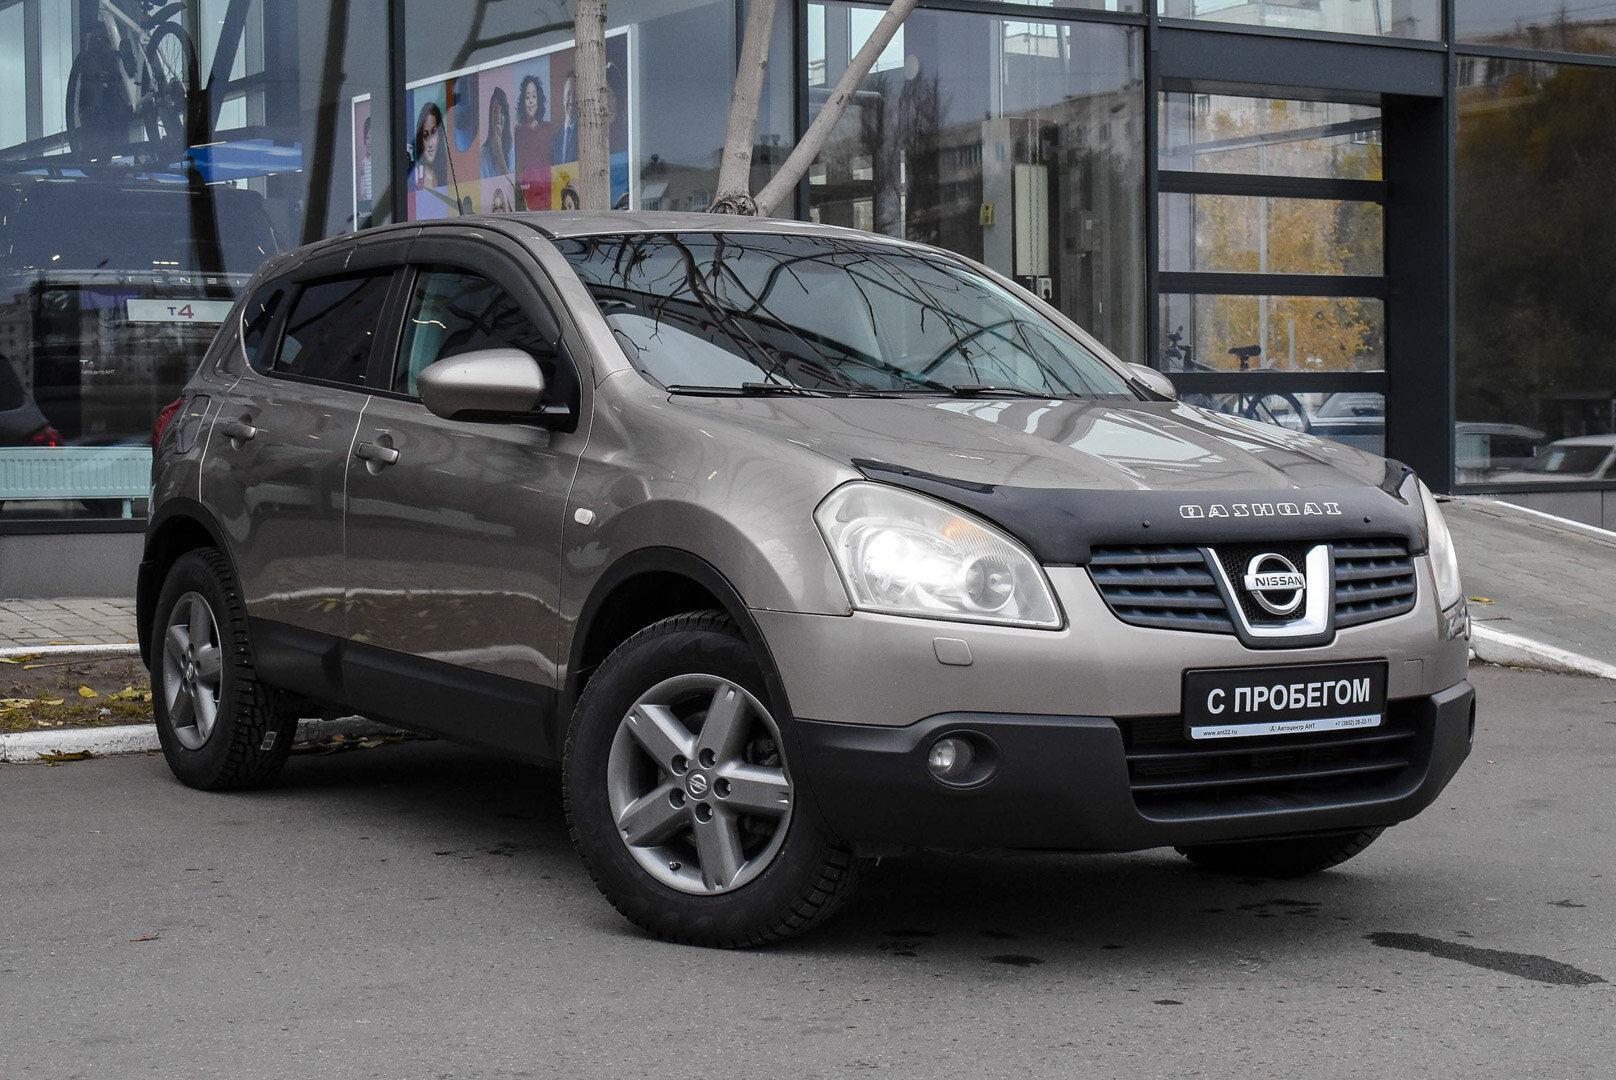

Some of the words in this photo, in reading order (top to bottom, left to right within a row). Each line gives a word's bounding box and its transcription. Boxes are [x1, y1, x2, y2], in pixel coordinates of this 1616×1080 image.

[167, 304, 194, 319] T4
[1180, 503, 1342, 519] QASHQAI
[1255, 576, 1303, 587] NISSAN
[1207, 688, 1225, 714] С
[1234, 678, 1370, 713] ПРОБЕГОМ
